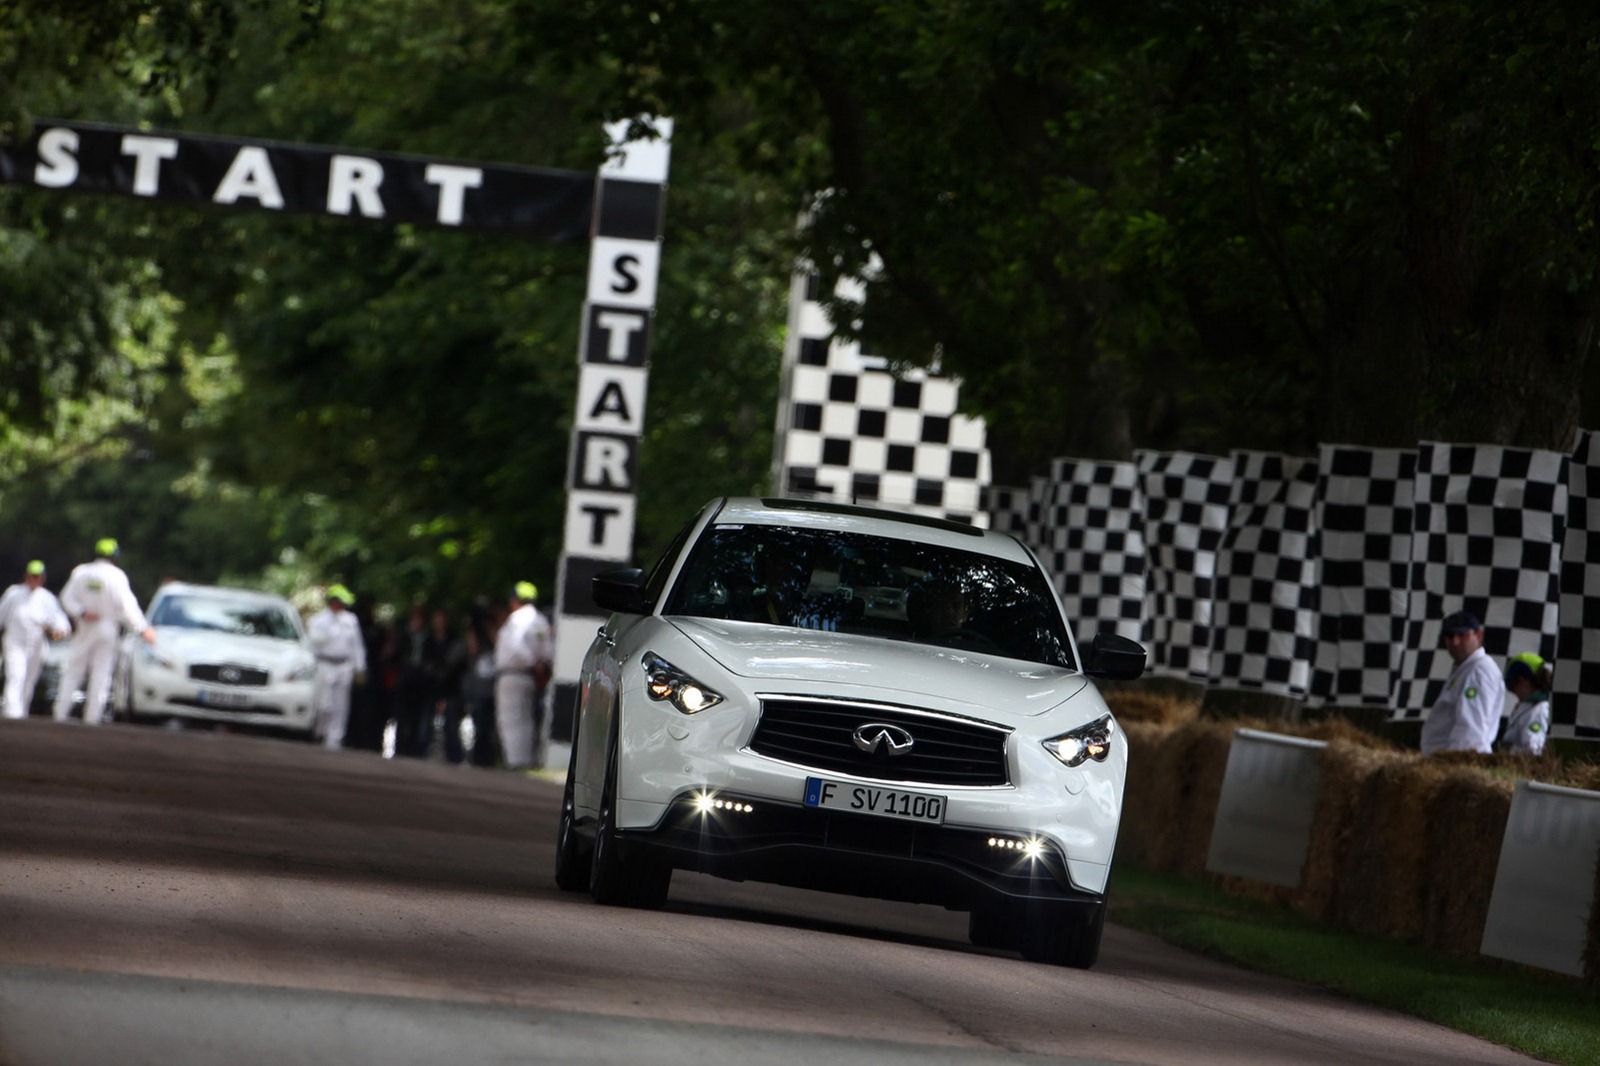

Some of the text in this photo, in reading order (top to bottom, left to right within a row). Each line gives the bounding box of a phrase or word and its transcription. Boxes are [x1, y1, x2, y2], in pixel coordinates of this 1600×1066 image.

[34, 129, 484, 225] START
[580, 253, 644, 548] START
[820, 783, 838, 805] F
